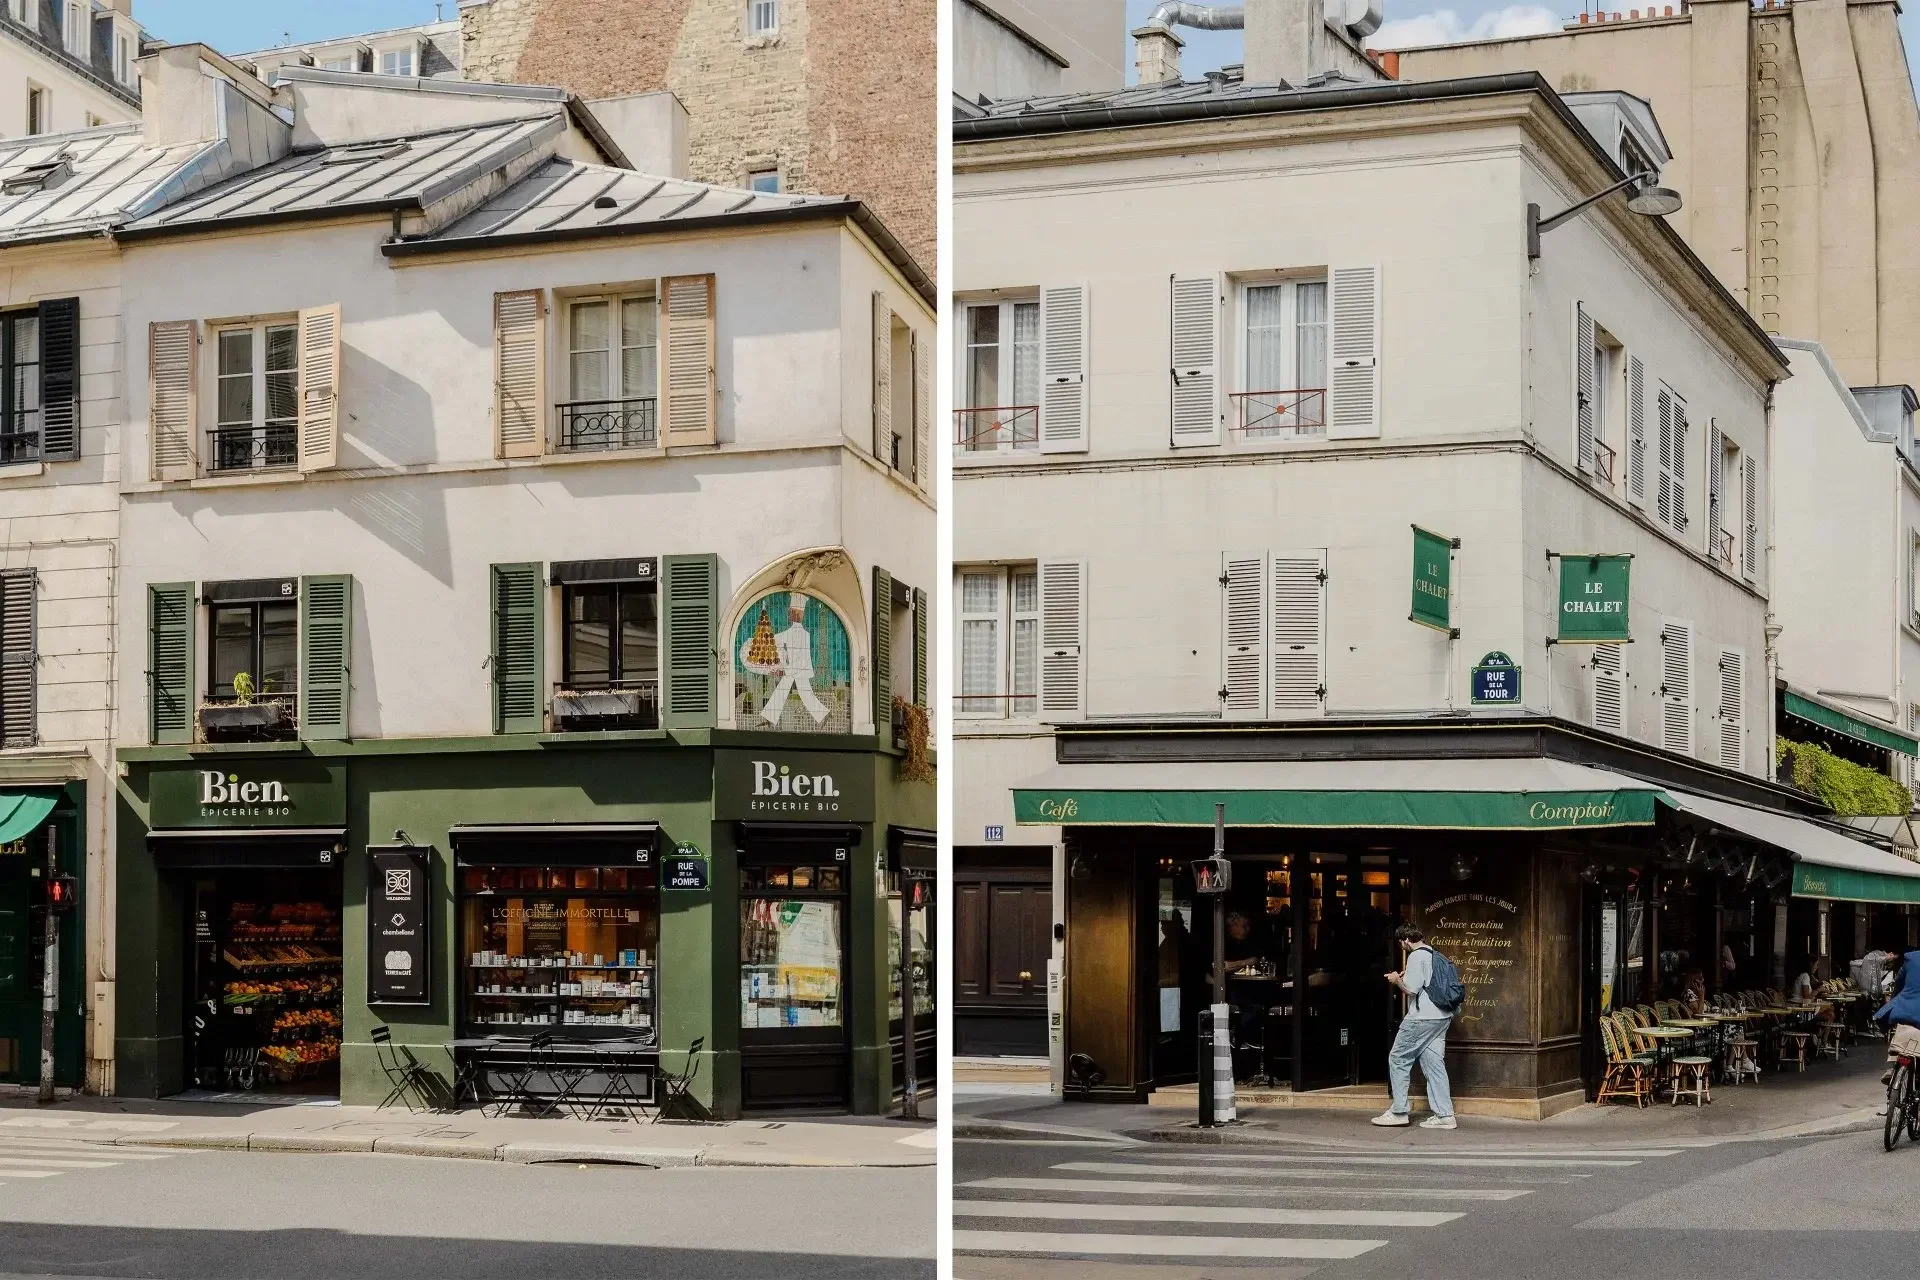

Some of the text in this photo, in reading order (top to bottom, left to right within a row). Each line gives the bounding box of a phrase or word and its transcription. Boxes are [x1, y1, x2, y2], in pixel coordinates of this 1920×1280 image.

[1428, 562, 1438, 576] LE
[1416, 579, 1447, 600] CHALET
[1584, 582, 1603, 594] LE
[1563, 601, 1623, 613] CHALET
[1486, 671, 1506, 682] RUE
[1483, 689, 1509, 699] TOUR
[751, 760, 840, 797] Bien.
[200, 770, 289, 804] Bien.
[201, 807, 289, 817] ÉPICERIE BIO
[751, 800, 839, 811] ÉPICERIE BIO
[1039, 798, 1078, 820] Café
[1529, 801, 1615, 825] Comptoir
[986, 827, 1001, 840] 112
[677, 862, 694, 871] RUE
[671, 877, 700, 886] POMPE
[1469, 893, 1483, 902] TOUS
[1485, 895, 1497, 904] LES
[1496, 899, 1518, 914] JOURS
[492, 907, 631, 919] L'OFFICINE IMMORTELLE
[1436, 916, 1504, 930] Service continu
[1430, 935, 1461, 947] Cuisine
[1470, 936, 1512, 948] tradition
